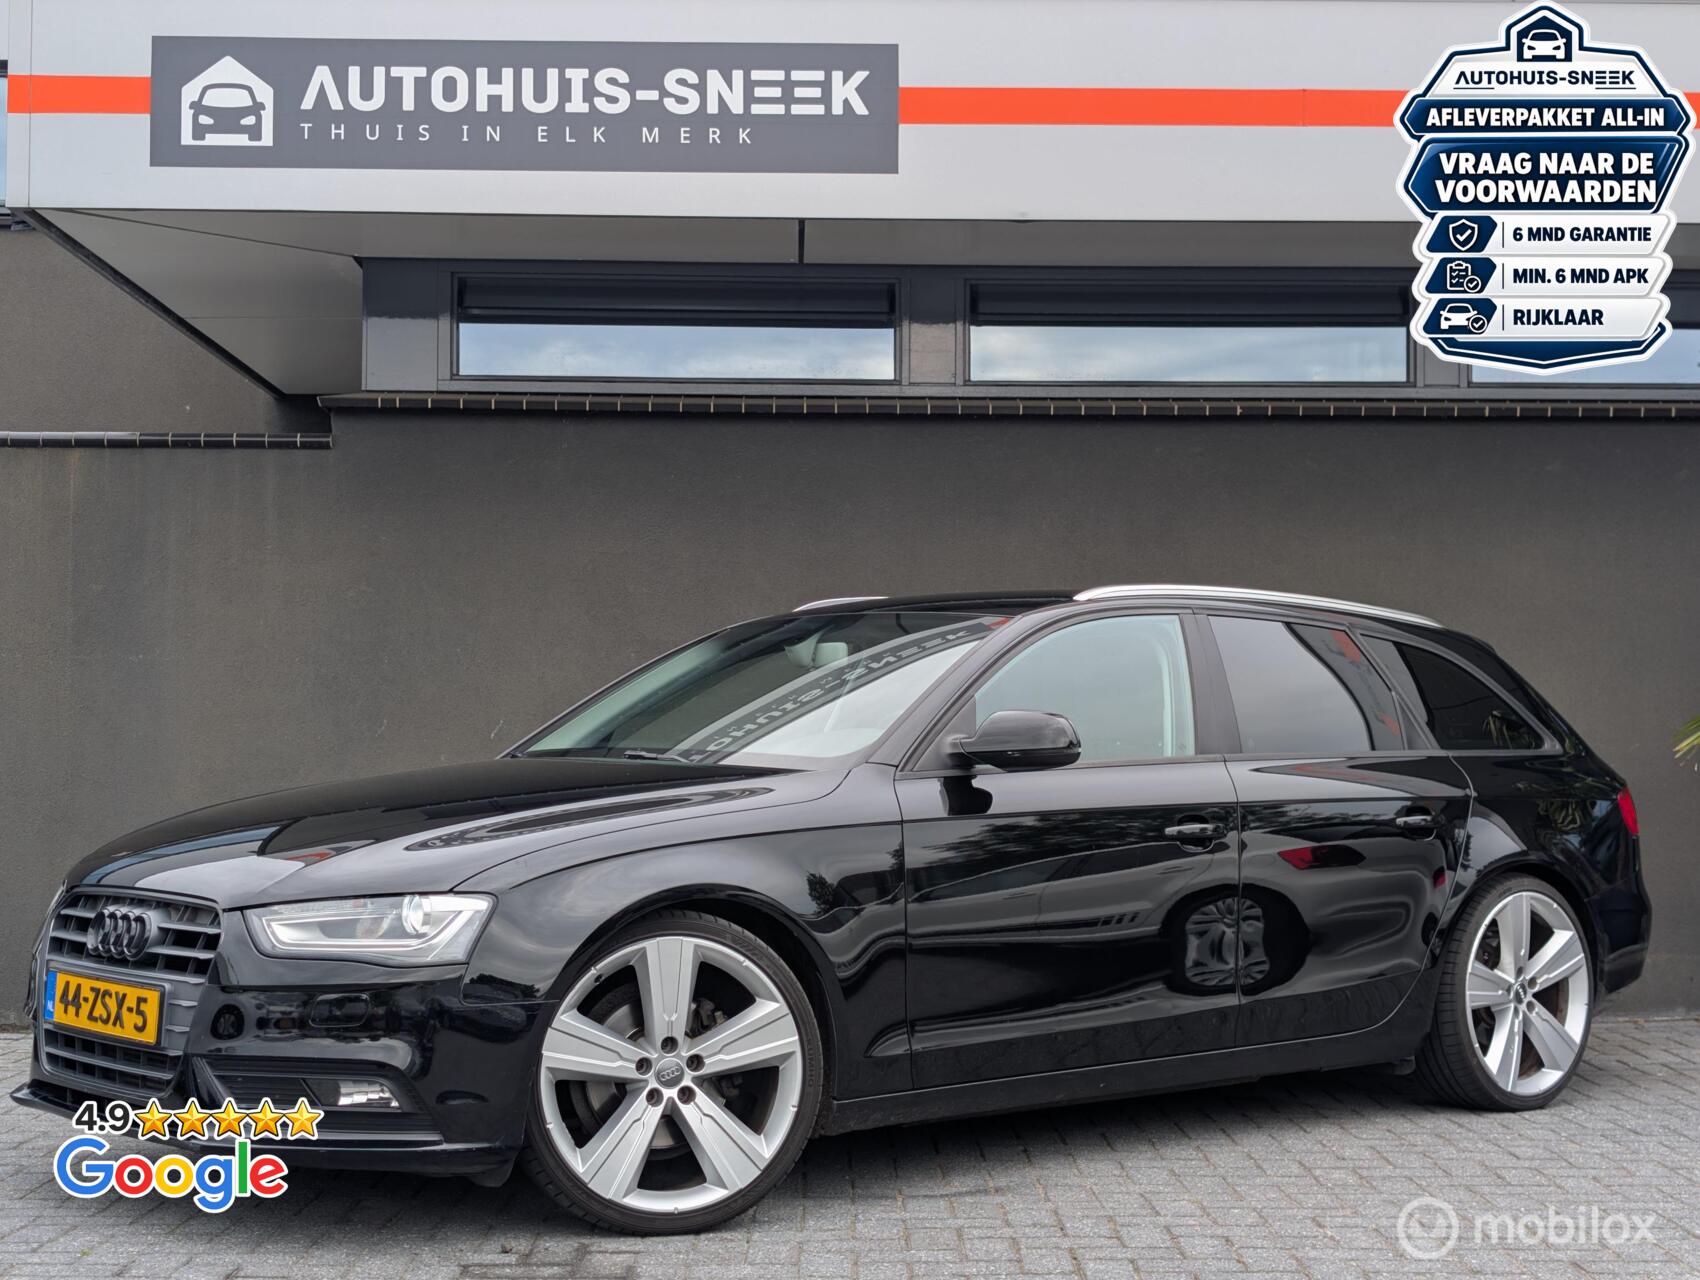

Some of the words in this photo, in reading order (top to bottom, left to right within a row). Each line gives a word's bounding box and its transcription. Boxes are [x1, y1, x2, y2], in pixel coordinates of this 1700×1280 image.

[300, 65, 870, 115] AUTOHUIS-SNEEK
[300, 123, 431, 141] THUIS
[462, 125, 500, 142] IN
[537, 126, 606, 143] ELK
[641, 127, 752, 144] MERK
[60, 981, 148, 1033] 44-ZSX-5
